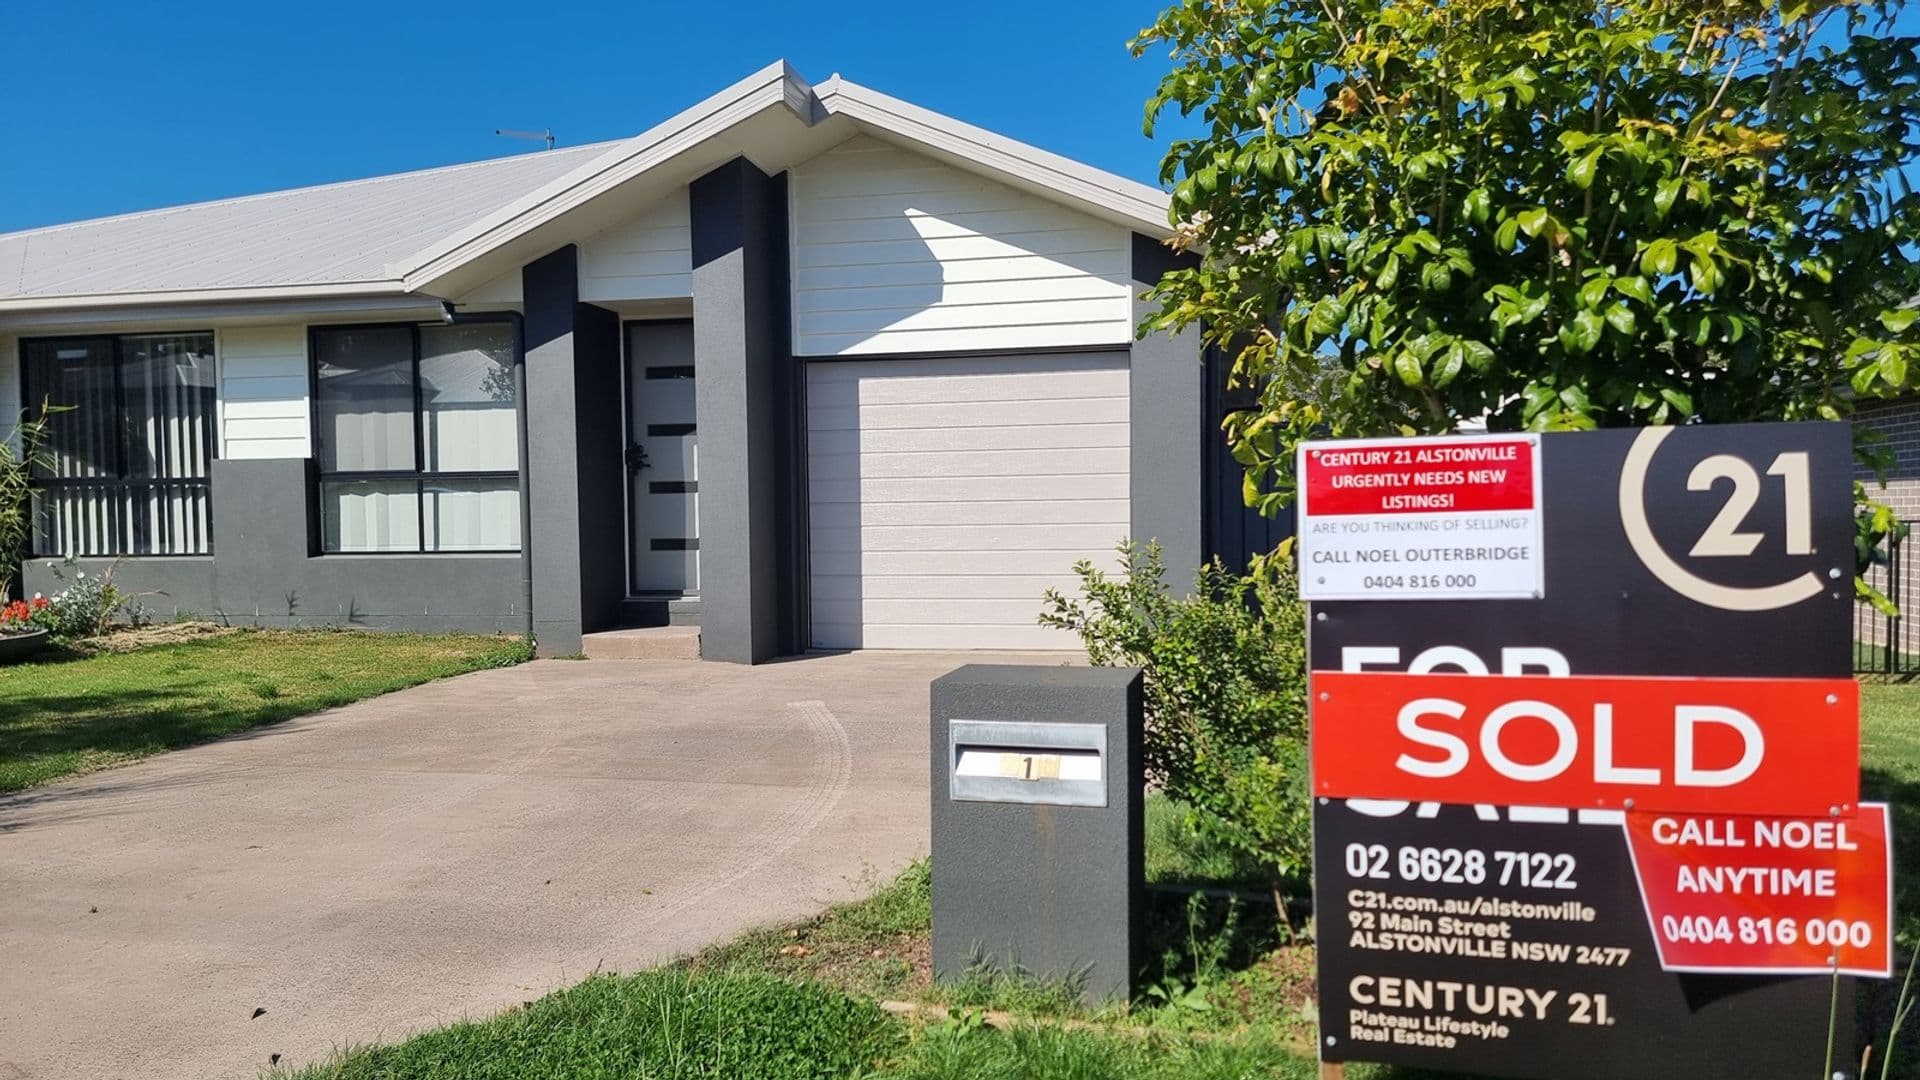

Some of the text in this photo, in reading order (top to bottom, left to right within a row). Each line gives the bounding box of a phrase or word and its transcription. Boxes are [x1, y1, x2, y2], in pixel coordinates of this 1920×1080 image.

[1320, 446, 1517, 467] CENTURY 21 ALSTONVILLE
[1332, 469, 1507, 489] URGENTLY NEEDS NEW
[1382, 494, 1454, 509] LISTINGS!
[1312, 518, 1529, 534] ARE YOU THINKING OF SELLING?
[1312, 546, 1529, 564] CALL NOEL OUTERBRIDGE
[1363, 574, 1476, 589] 0404 816 000
[1395, 698, 1765, 787] SOLD
[1023, 757, 1033, 779] 1
[1652, 817, 1858, 850] CALL NOEL
[1345, 843, 1577, 890] 02 6628 7122
[1676, 865, 1836, 897] ANYTIME
[1348, 890, 1596, 923] C21.com.au/alstonville
[1348, 912, 1512, 940] 92 Main Street
[1662, 915, 1872, 949] 0404 816 000
[1350, 931, 1631, 968] ALSTONVILLE NSW 2477
[1350, 975, 1558, 1020] CENTURY
[1350, 1009, 1510, 1040] Plateau Lifestyle
[1350, 1026, 1457, 1049] Real Estate
